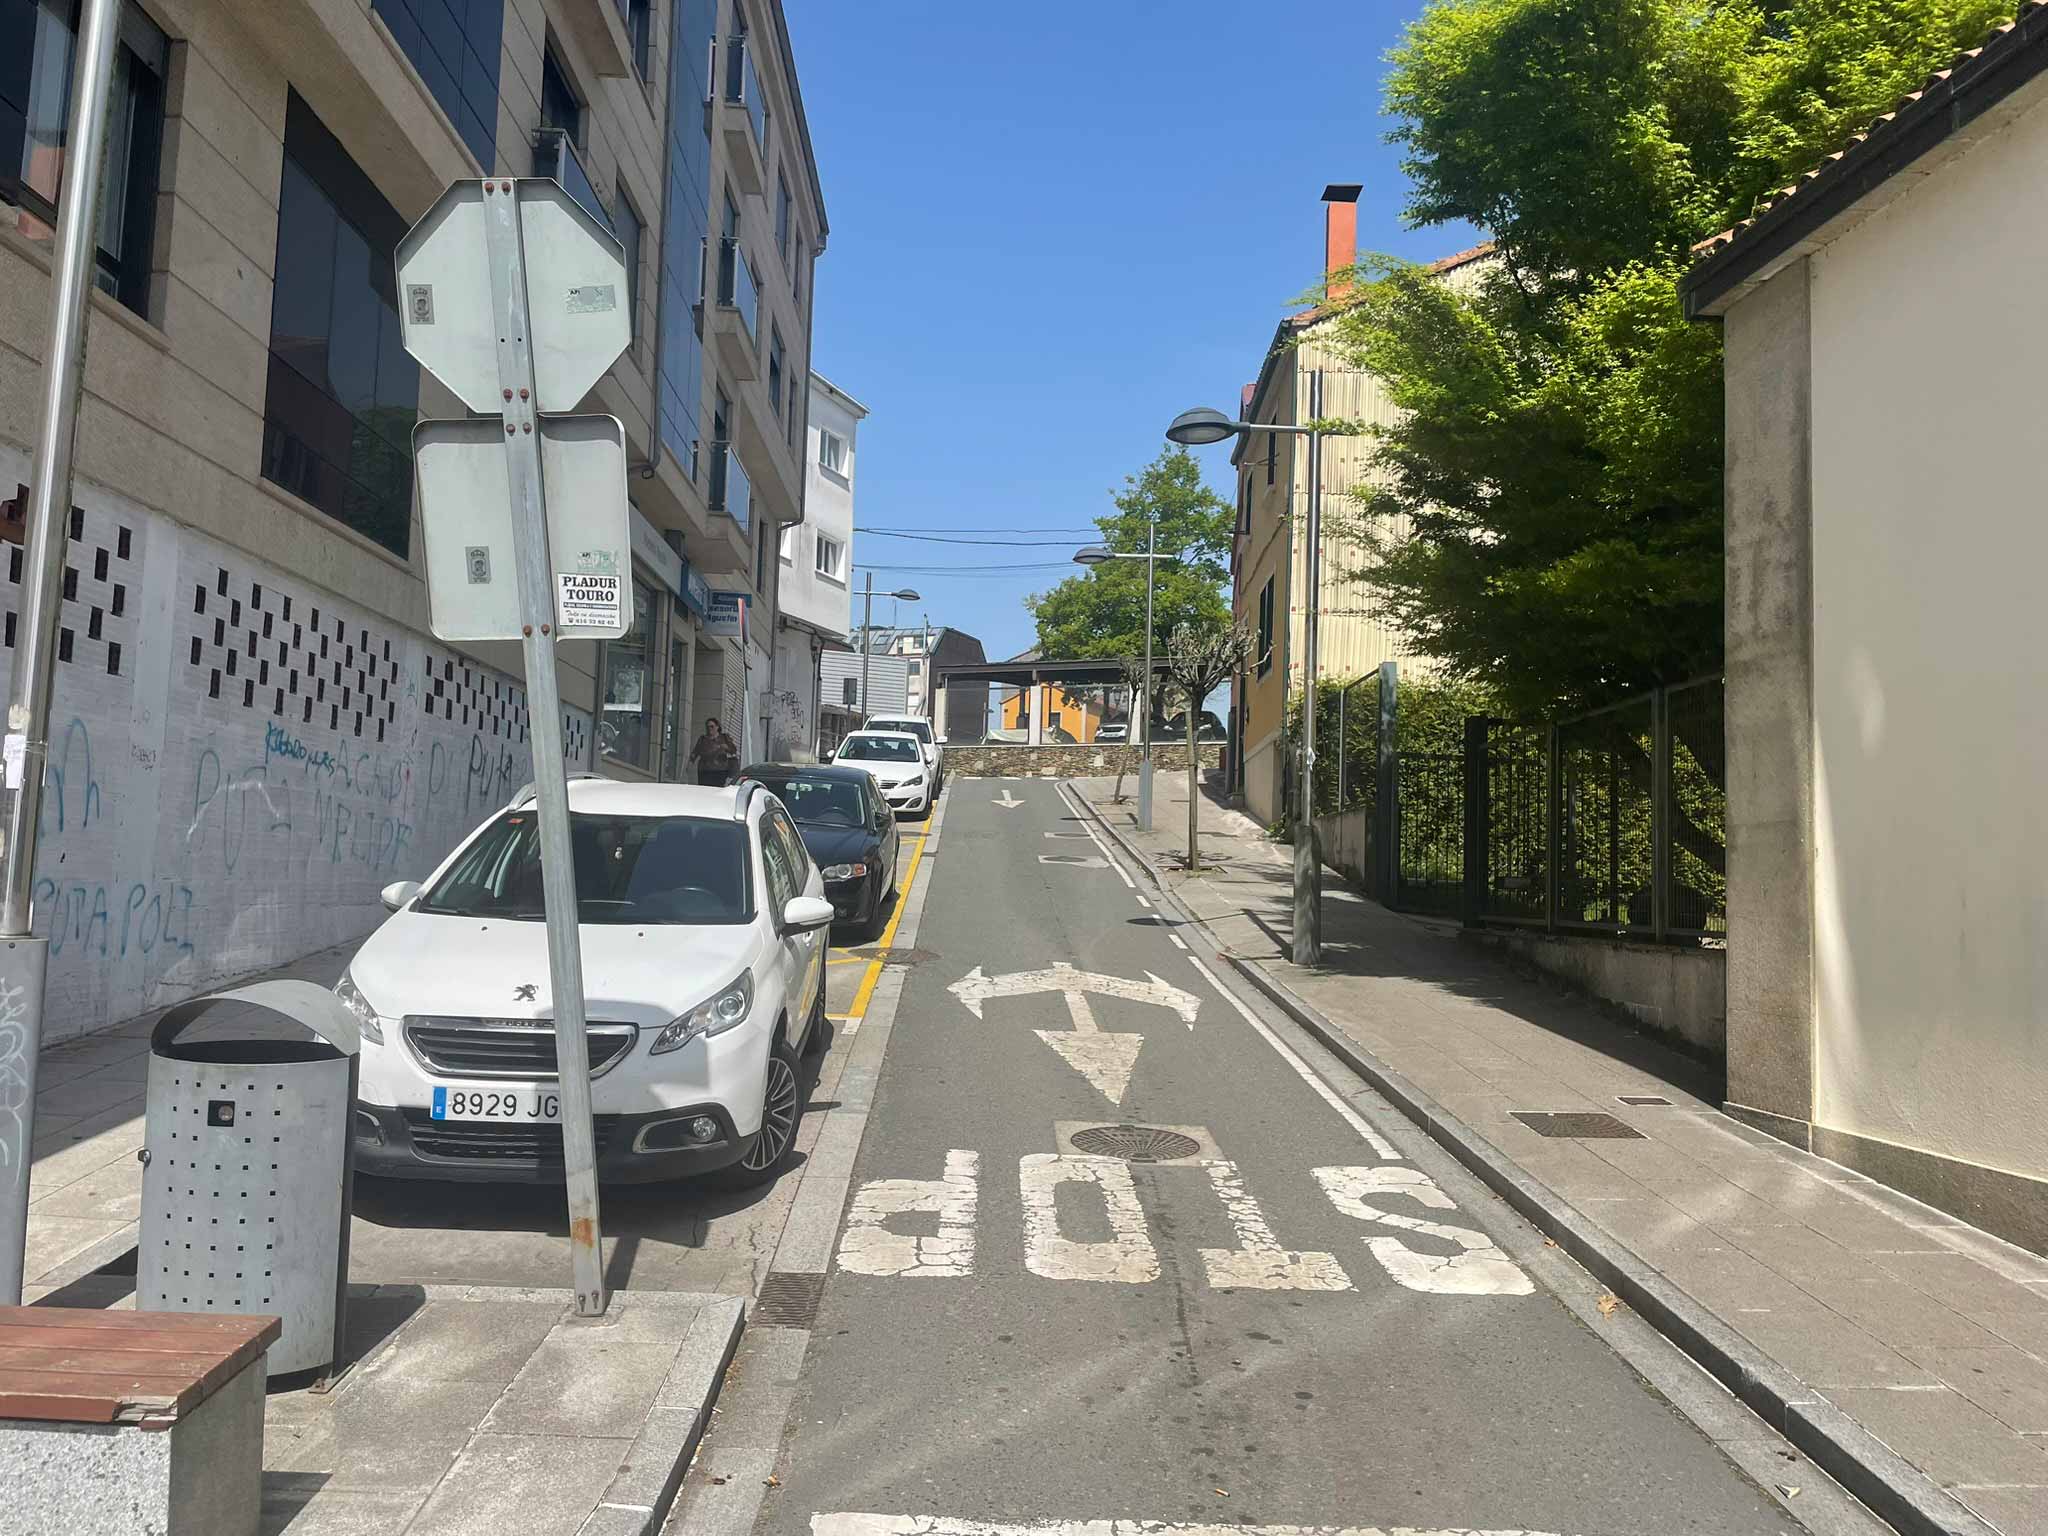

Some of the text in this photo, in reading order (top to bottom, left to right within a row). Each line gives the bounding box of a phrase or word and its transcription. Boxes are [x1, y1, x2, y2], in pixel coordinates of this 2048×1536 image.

[563, 576, 617, 588] PLADUR
[567, 589, 614, 601] TOURO
[452, 1092, 518, 1117] 8929
[528, 1095, 559, 1118] JG
[836, 1148, 1537, 1296] STOP
